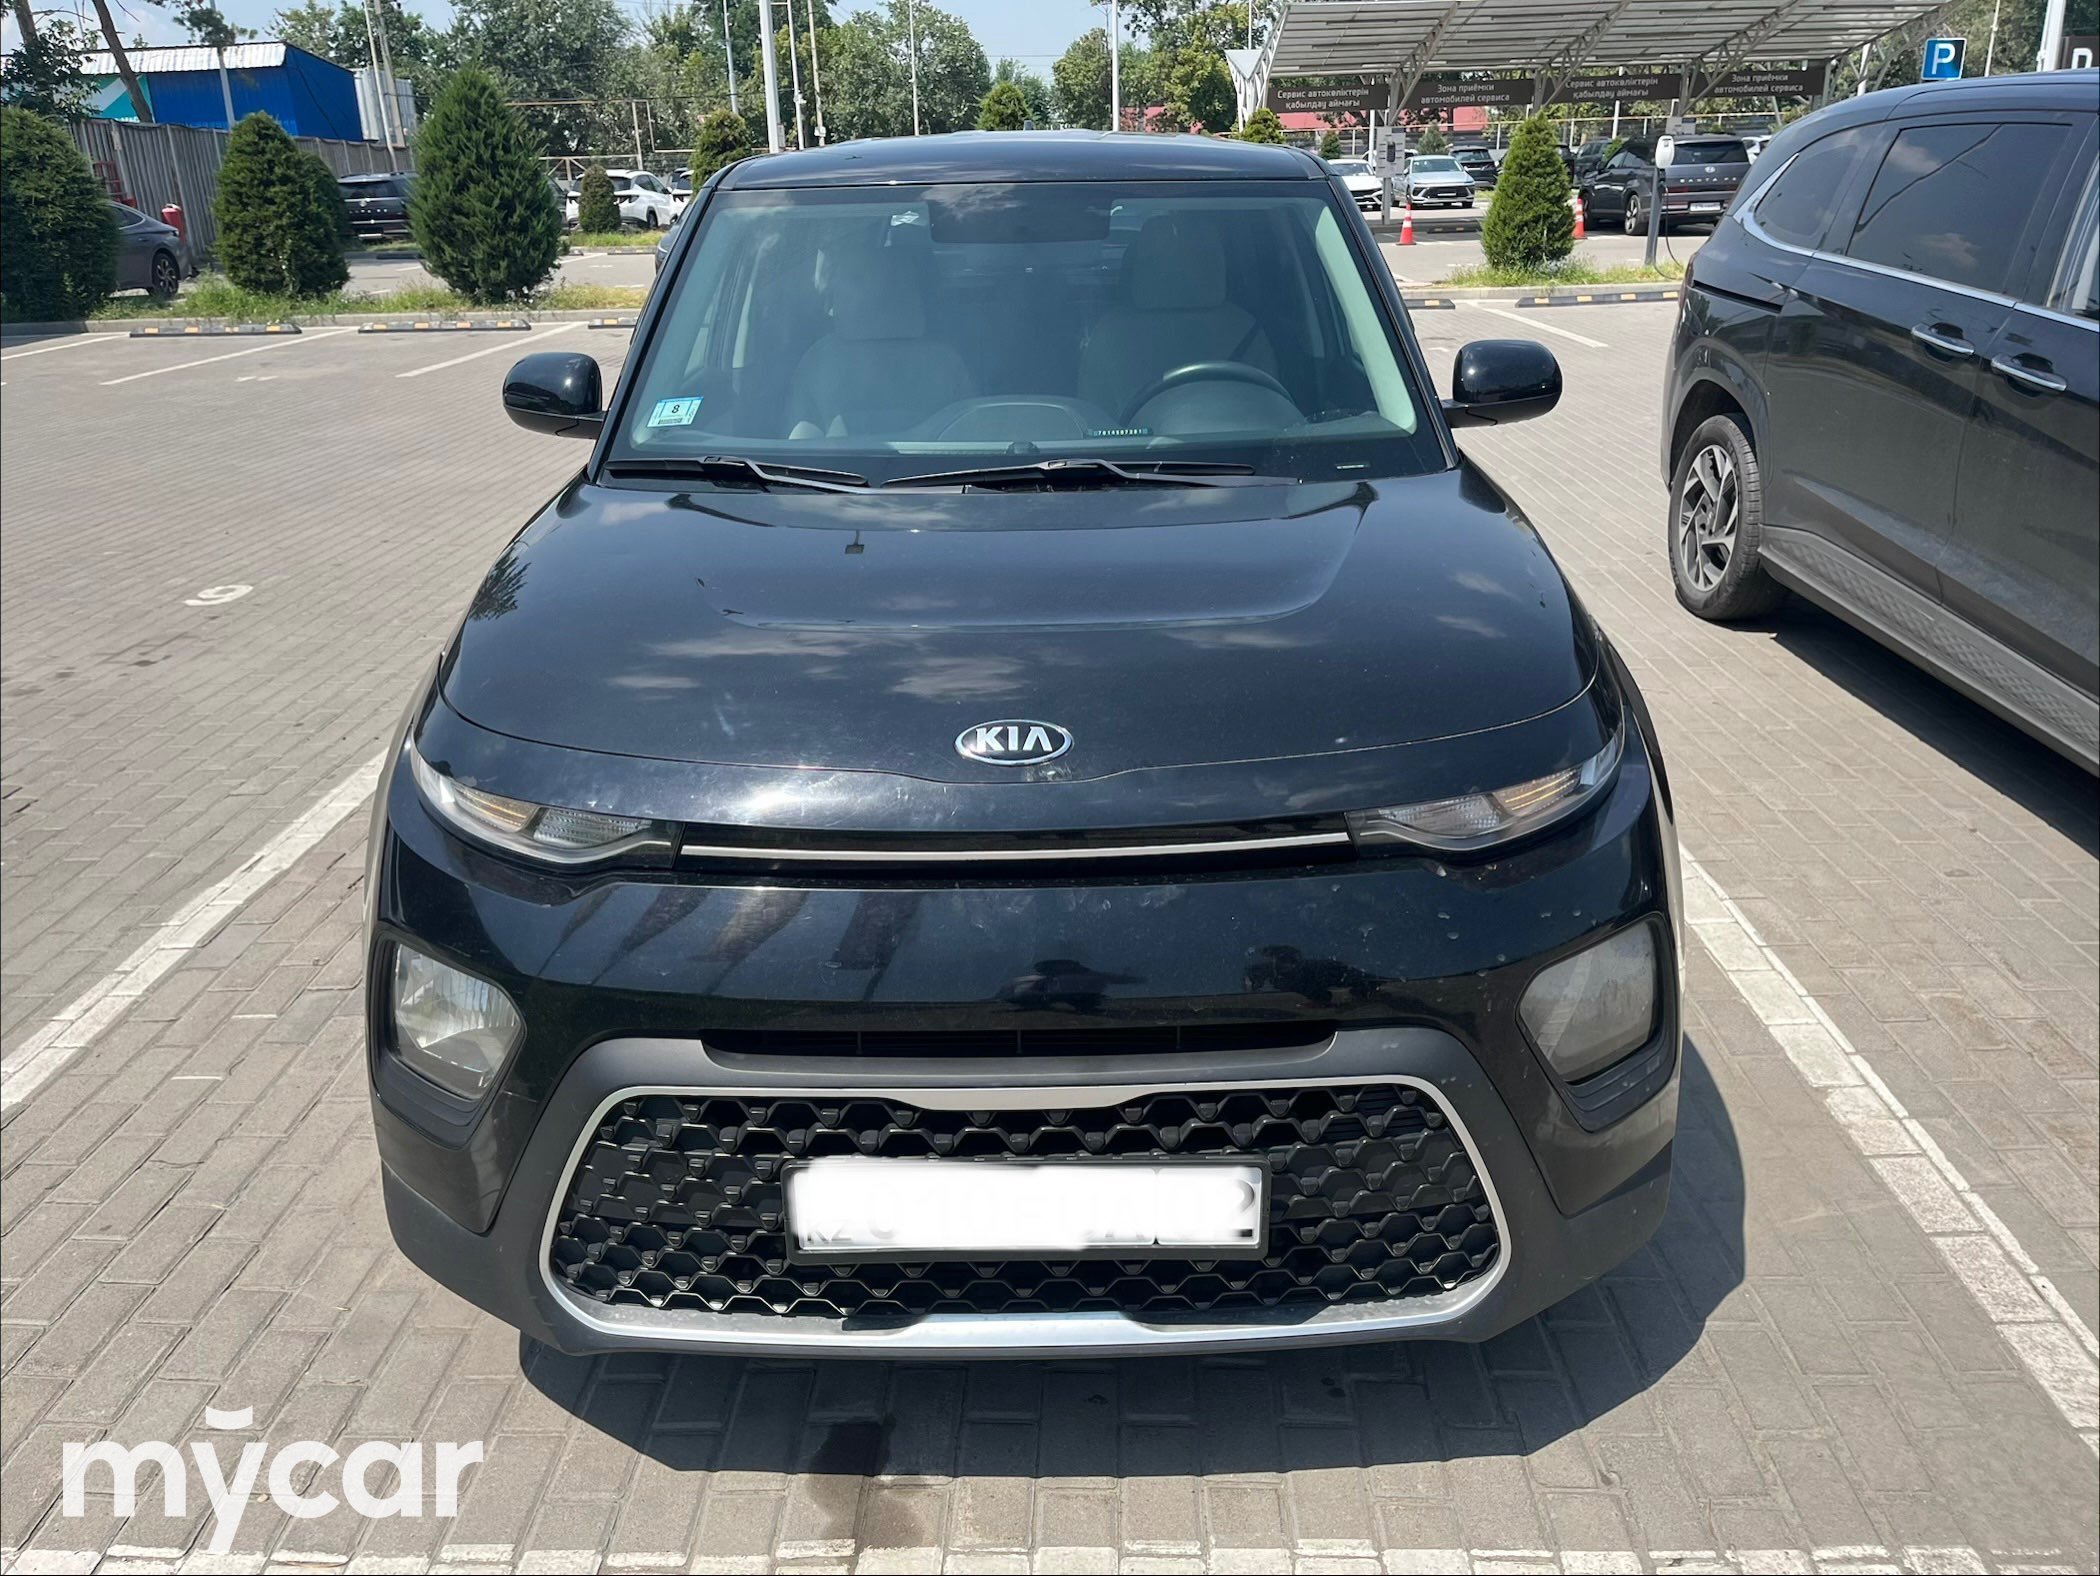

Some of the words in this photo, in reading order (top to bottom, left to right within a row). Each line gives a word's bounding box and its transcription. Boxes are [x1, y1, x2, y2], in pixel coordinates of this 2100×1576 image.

[1931, 43, 1956, 75] P
[1732, 74, 1751, 83] Зона
[1437, 84, 1456, 93] Зона
[1565, 80, 1594, 89] Сервис
[1771, 85, 1804, 93] сервиса
[1277, 90, 1305, 99] Сервис
[1421, 94, 1475, 104] автомобилей
[1477, 94, 1510, 103] сервиса
[671, 404, 680, 414] 8
[975, 725, 1053, 752] KIA
